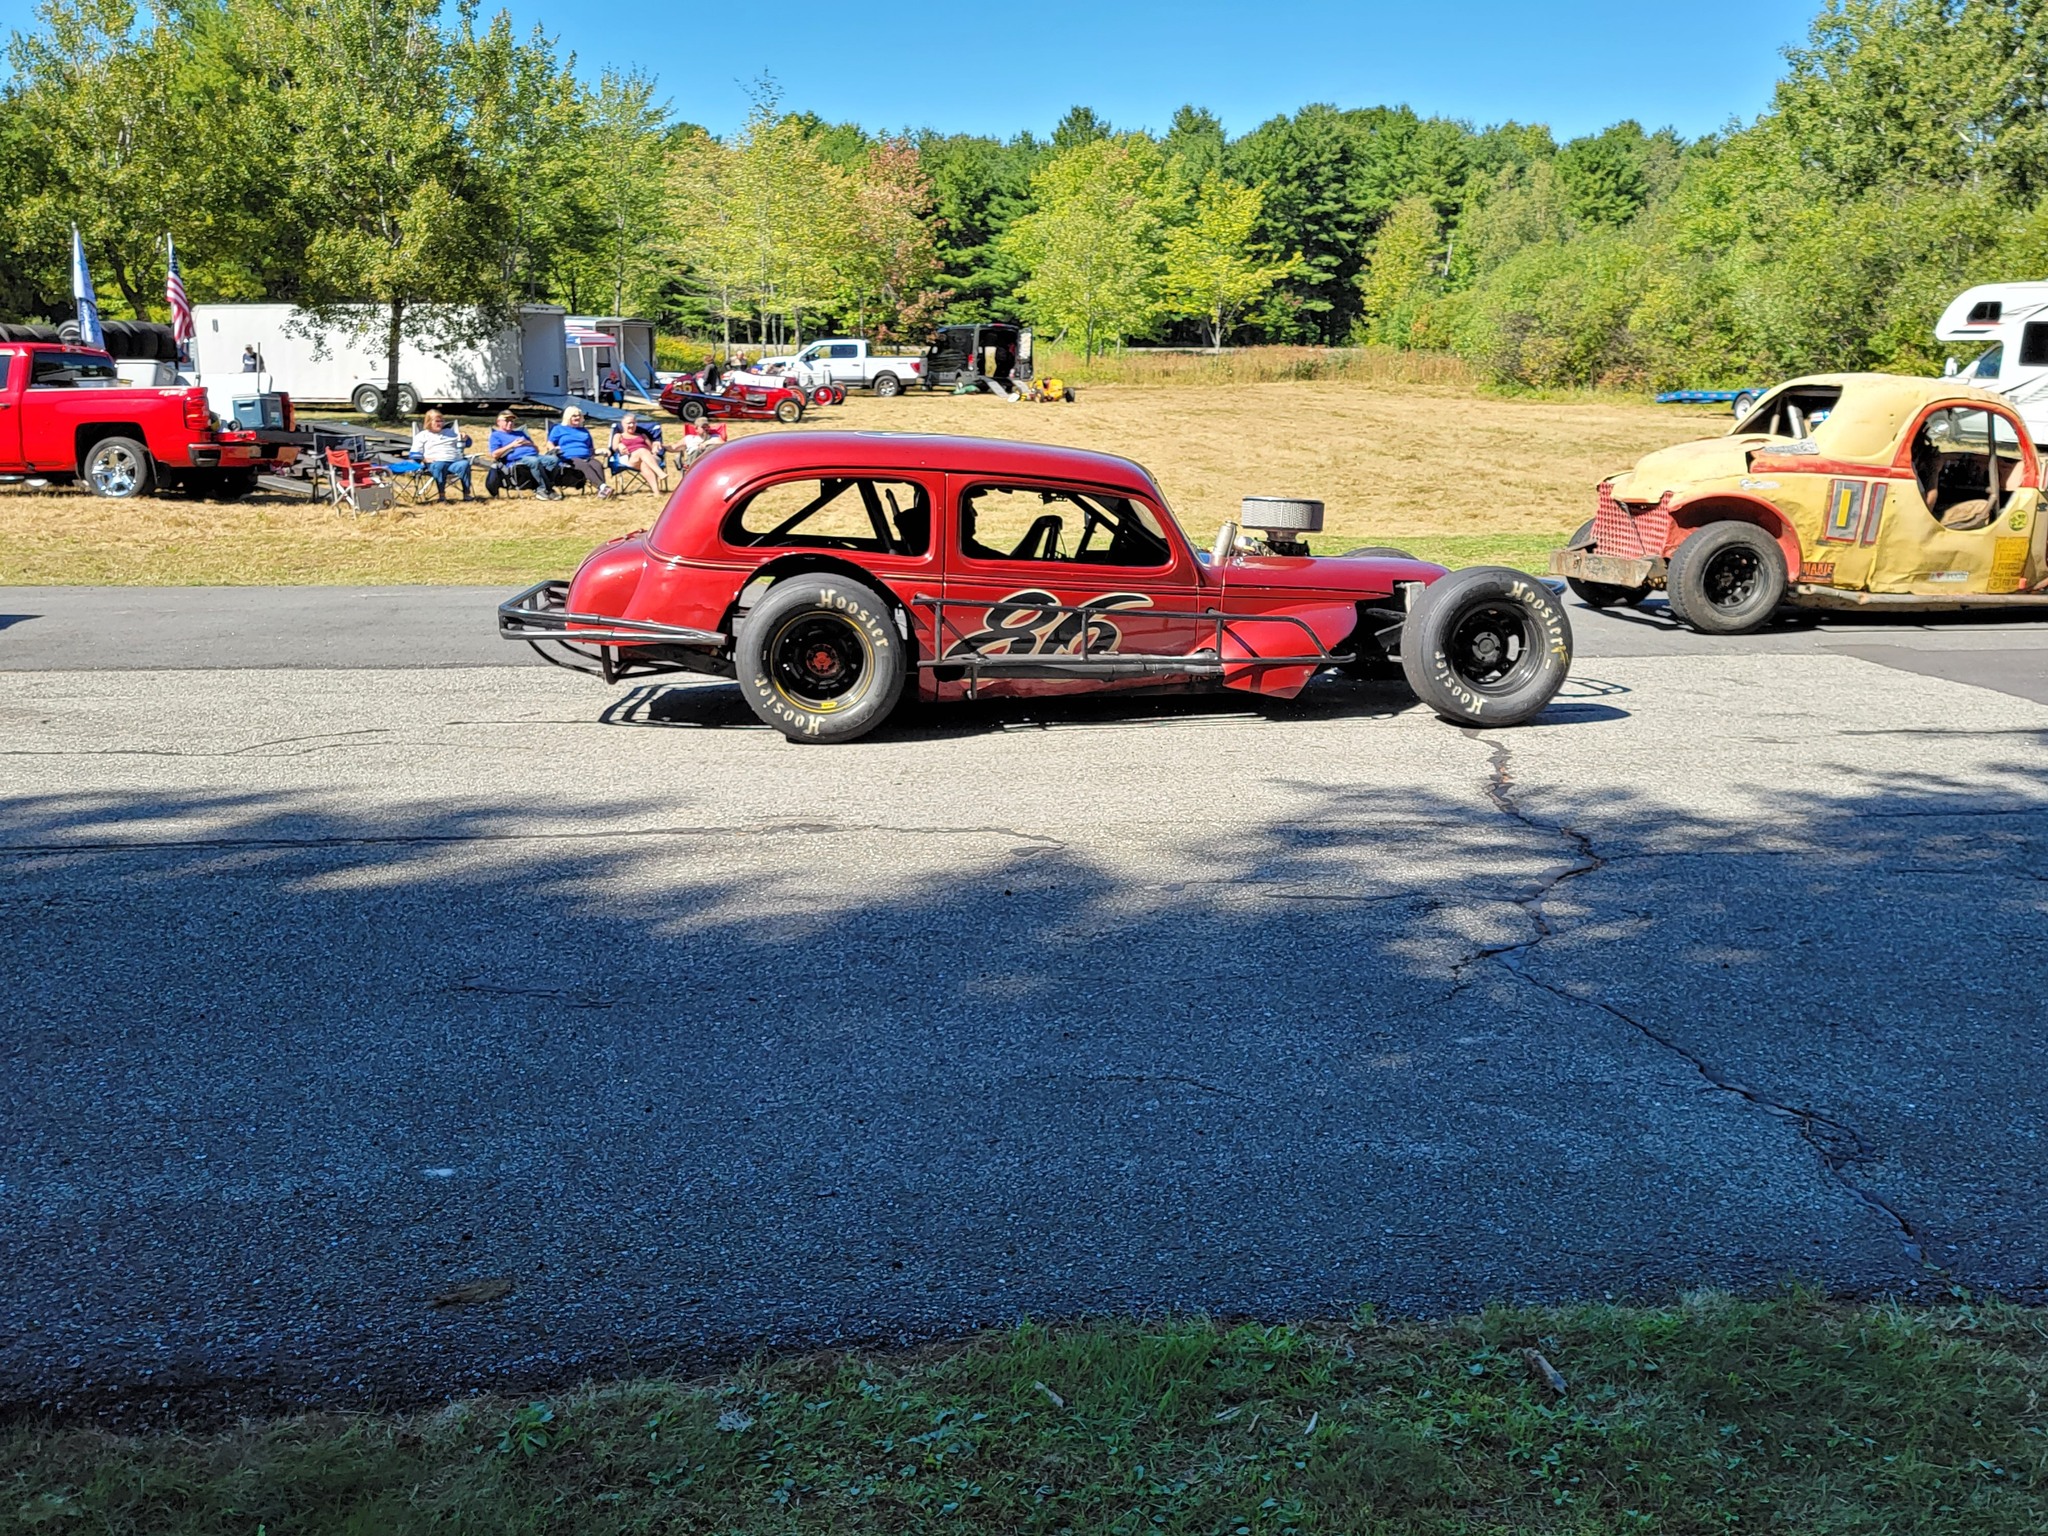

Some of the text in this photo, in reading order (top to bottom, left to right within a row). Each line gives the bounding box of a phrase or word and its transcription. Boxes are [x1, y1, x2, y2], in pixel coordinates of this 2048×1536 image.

[815, 588, 890, 648] Hoosier
[941, 588, 1155, 682] 86
[1505, 581, 1564, 645] Hoosier
[753, 673, 827, 736] Hoosier
[1434, 651, 1488, 715] Hoosier
